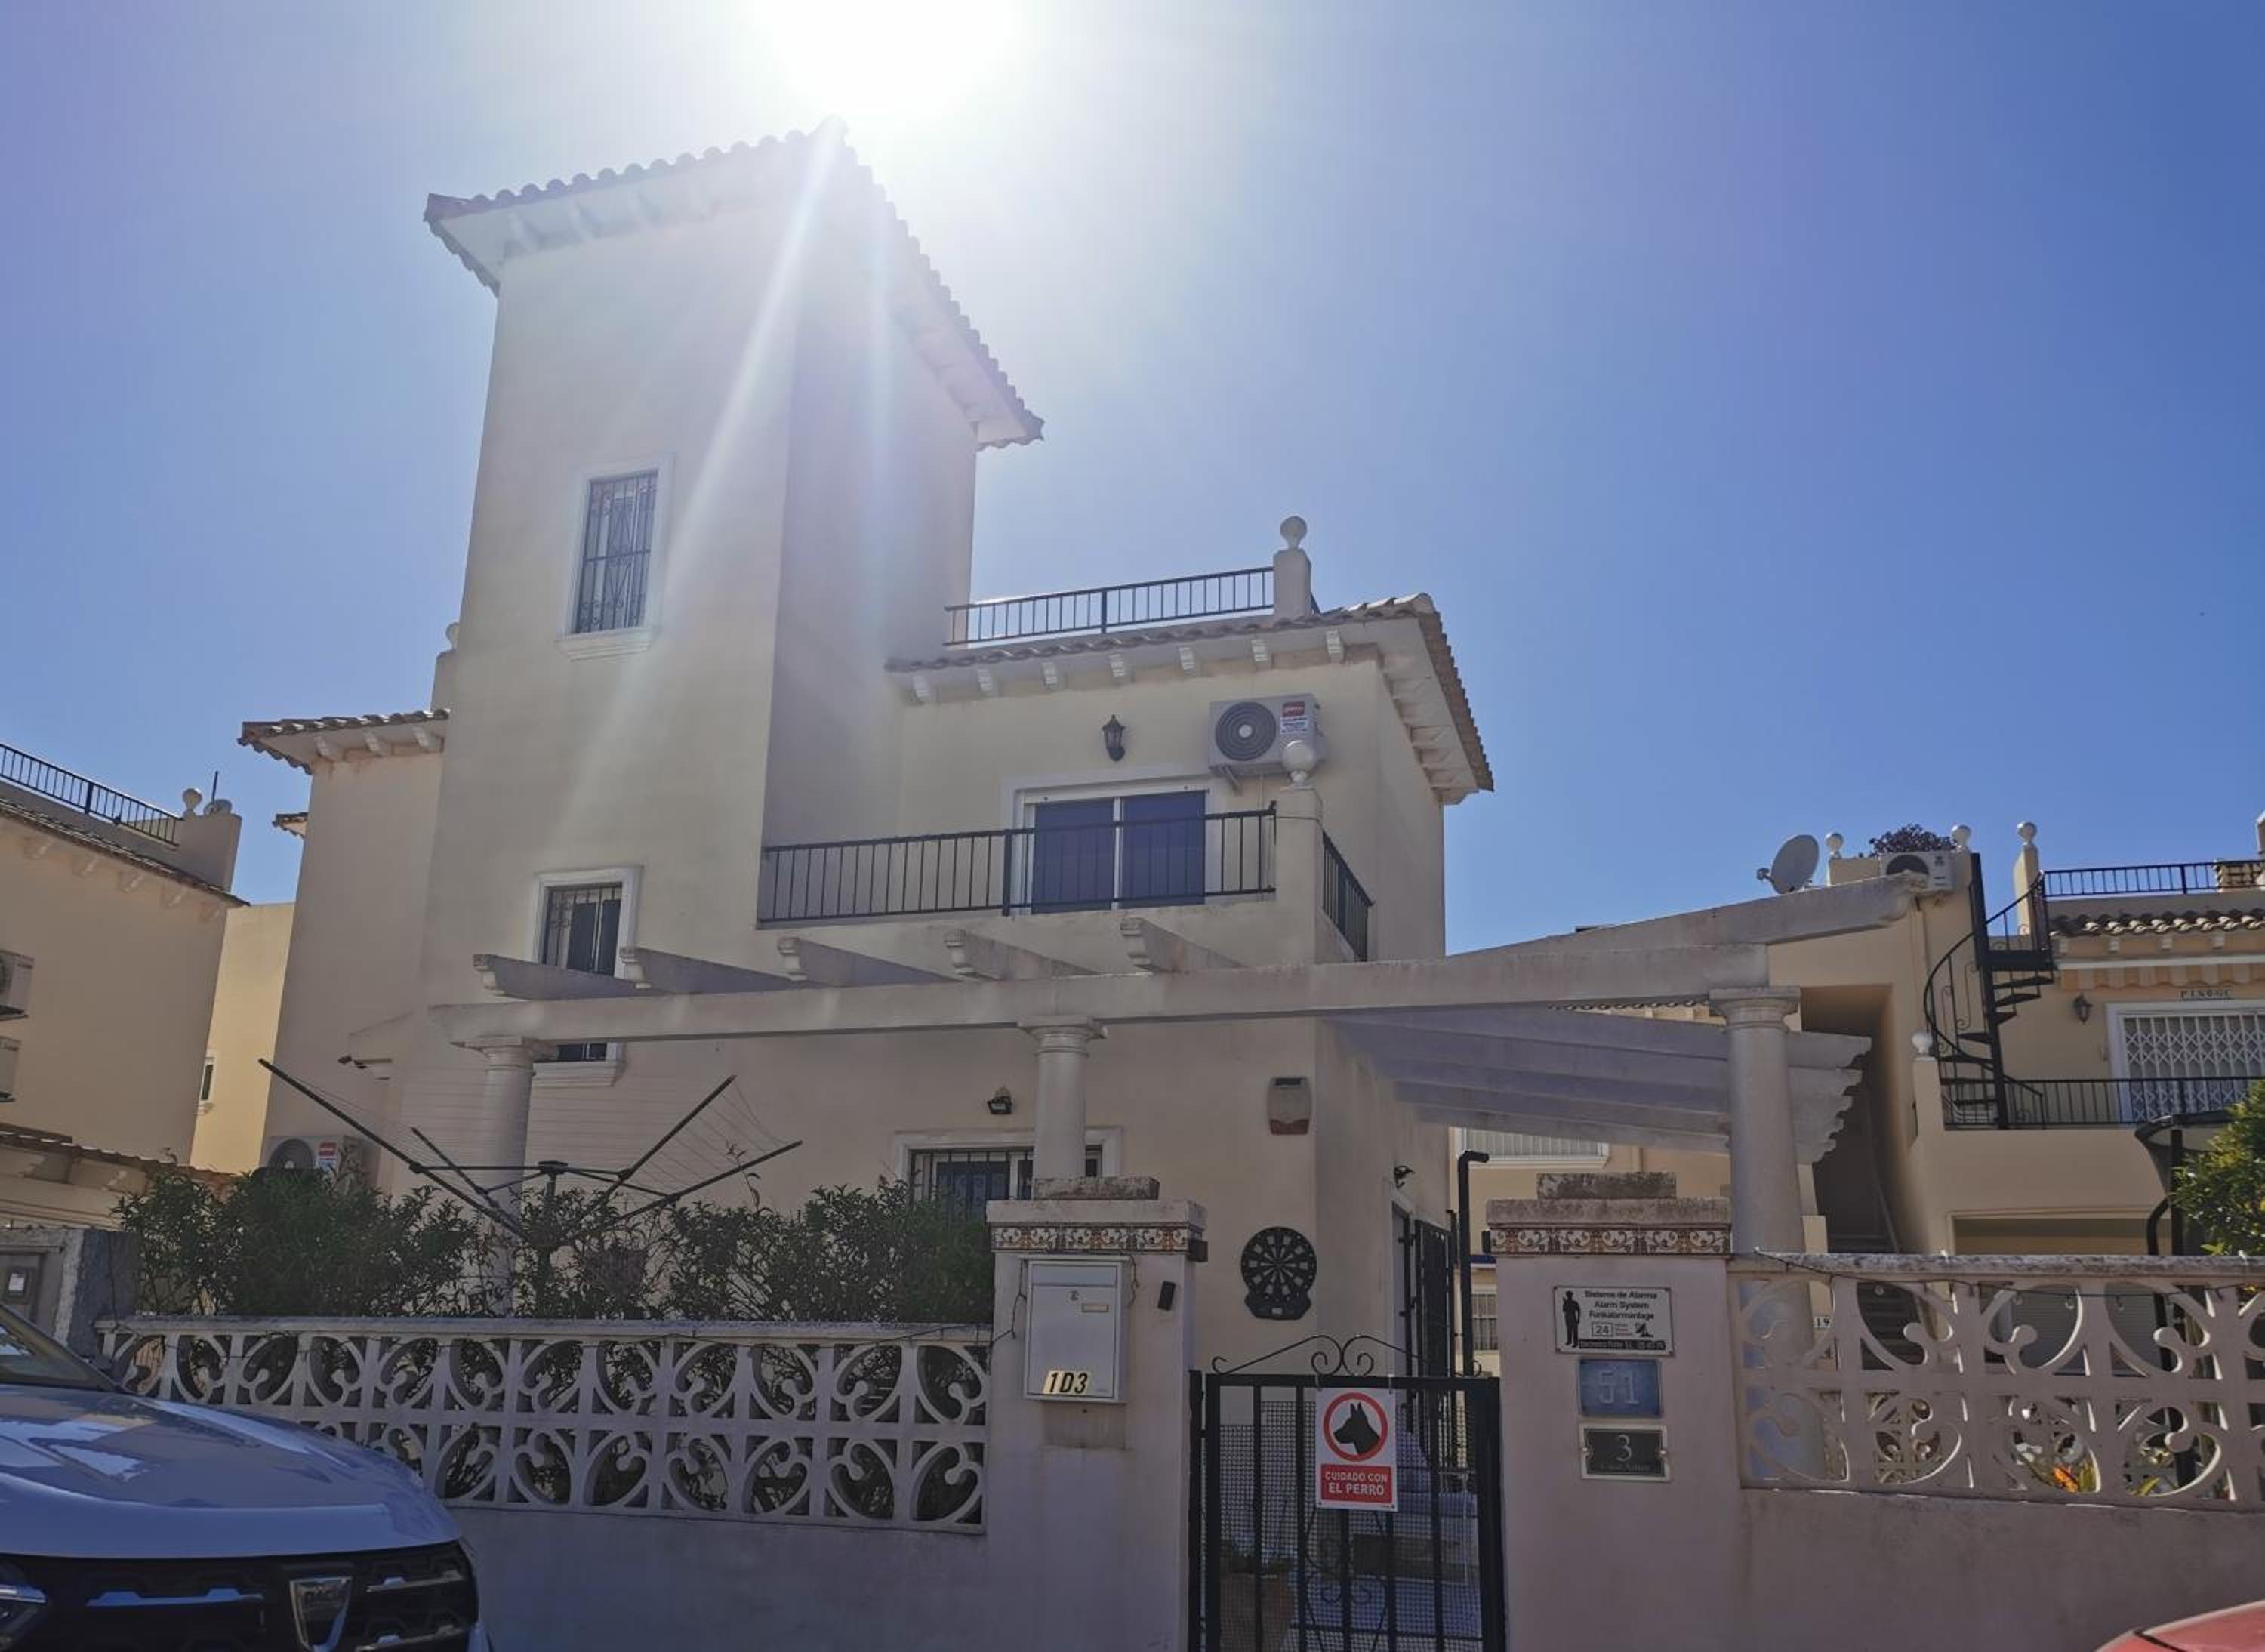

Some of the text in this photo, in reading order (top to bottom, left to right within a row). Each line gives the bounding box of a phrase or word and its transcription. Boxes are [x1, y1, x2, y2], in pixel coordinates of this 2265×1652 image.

[1629, 1291, 1657, 1299] Alarma
[1619, 1301, 1650, 1311] System
[1595, 1325, 1609, 1334] 24
[1049, 1372, 1088, 1394] 1D3
[1598, 1369, 1639, 1404] 51
[1616, 1434, 1632, 1462] 3
[1325, 1471, 1388, 1482] CUIDADO CON
[1328, 1482, 1385, 1496] EL PERRO
